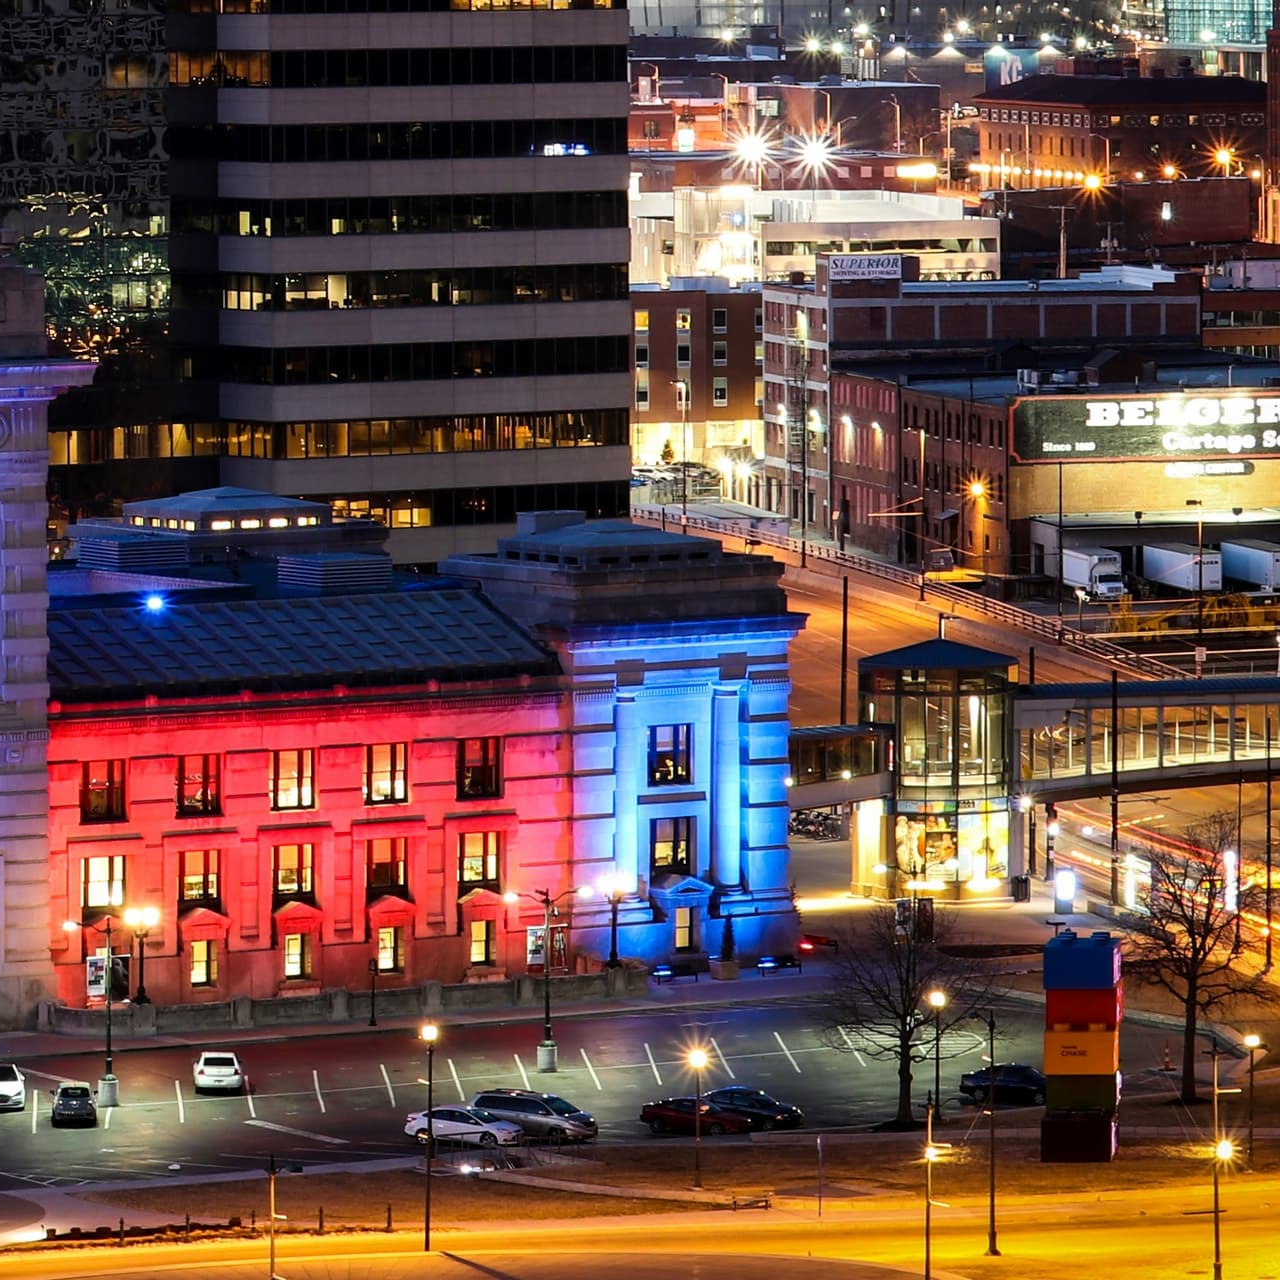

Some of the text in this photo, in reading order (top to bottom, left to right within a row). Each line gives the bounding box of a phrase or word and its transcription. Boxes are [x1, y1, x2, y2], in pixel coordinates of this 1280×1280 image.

[1000, 56, 1023, 86] KC
[831, 257, 900, 270] SUPERIOR
[1042, 442, 1072, 452] Since
[1161, 431, 1256, 453] Cartage
